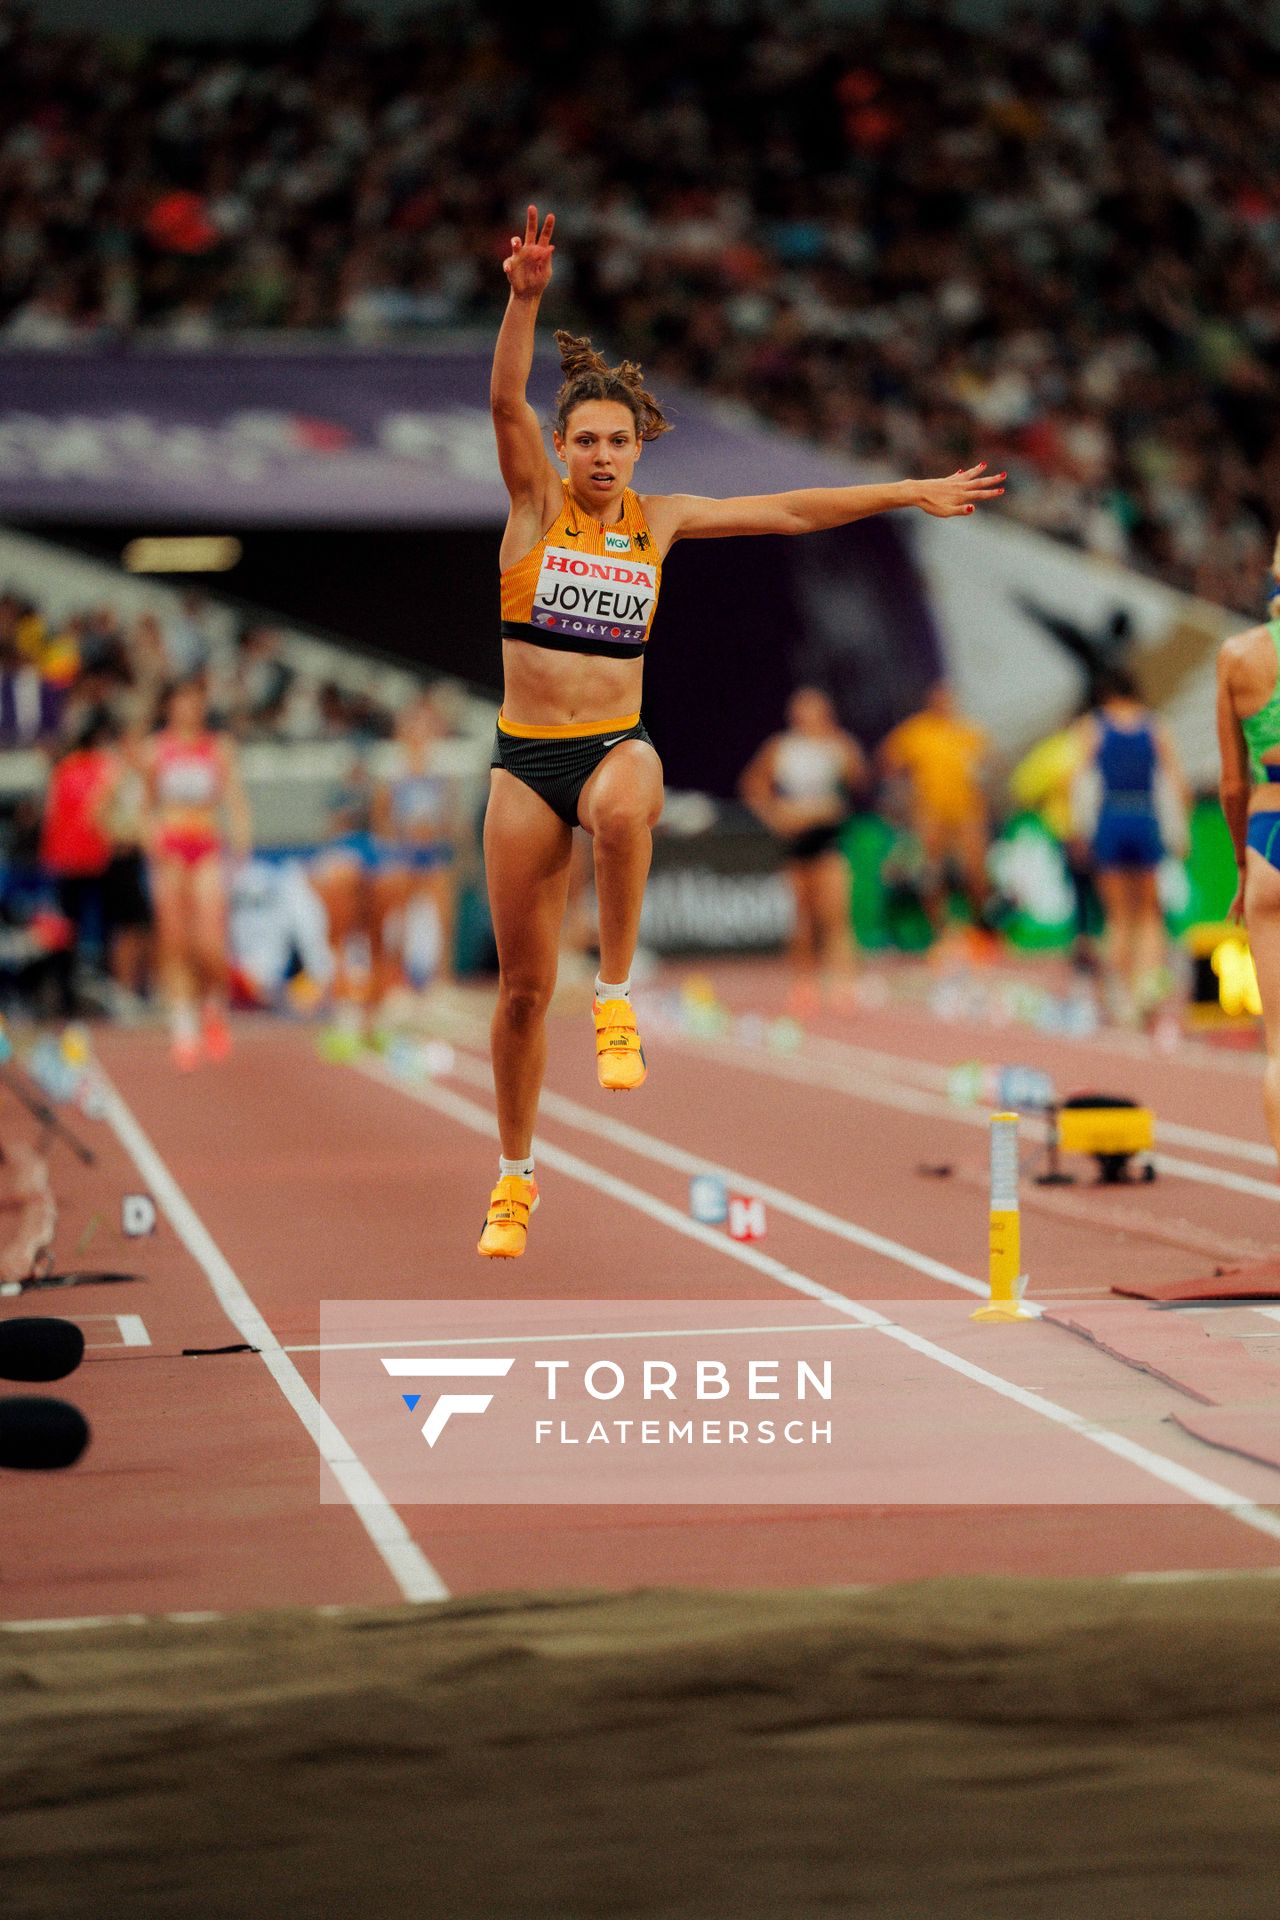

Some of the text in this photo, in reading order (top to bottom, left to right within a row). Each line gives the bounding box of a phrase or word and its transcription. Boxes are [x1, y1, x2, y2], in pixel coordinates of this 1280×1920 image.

[605, 536, 630, 549] WGV
[543, 554, 654, 589] HONDA
[541, 583, 650, 621] JOYEUX
